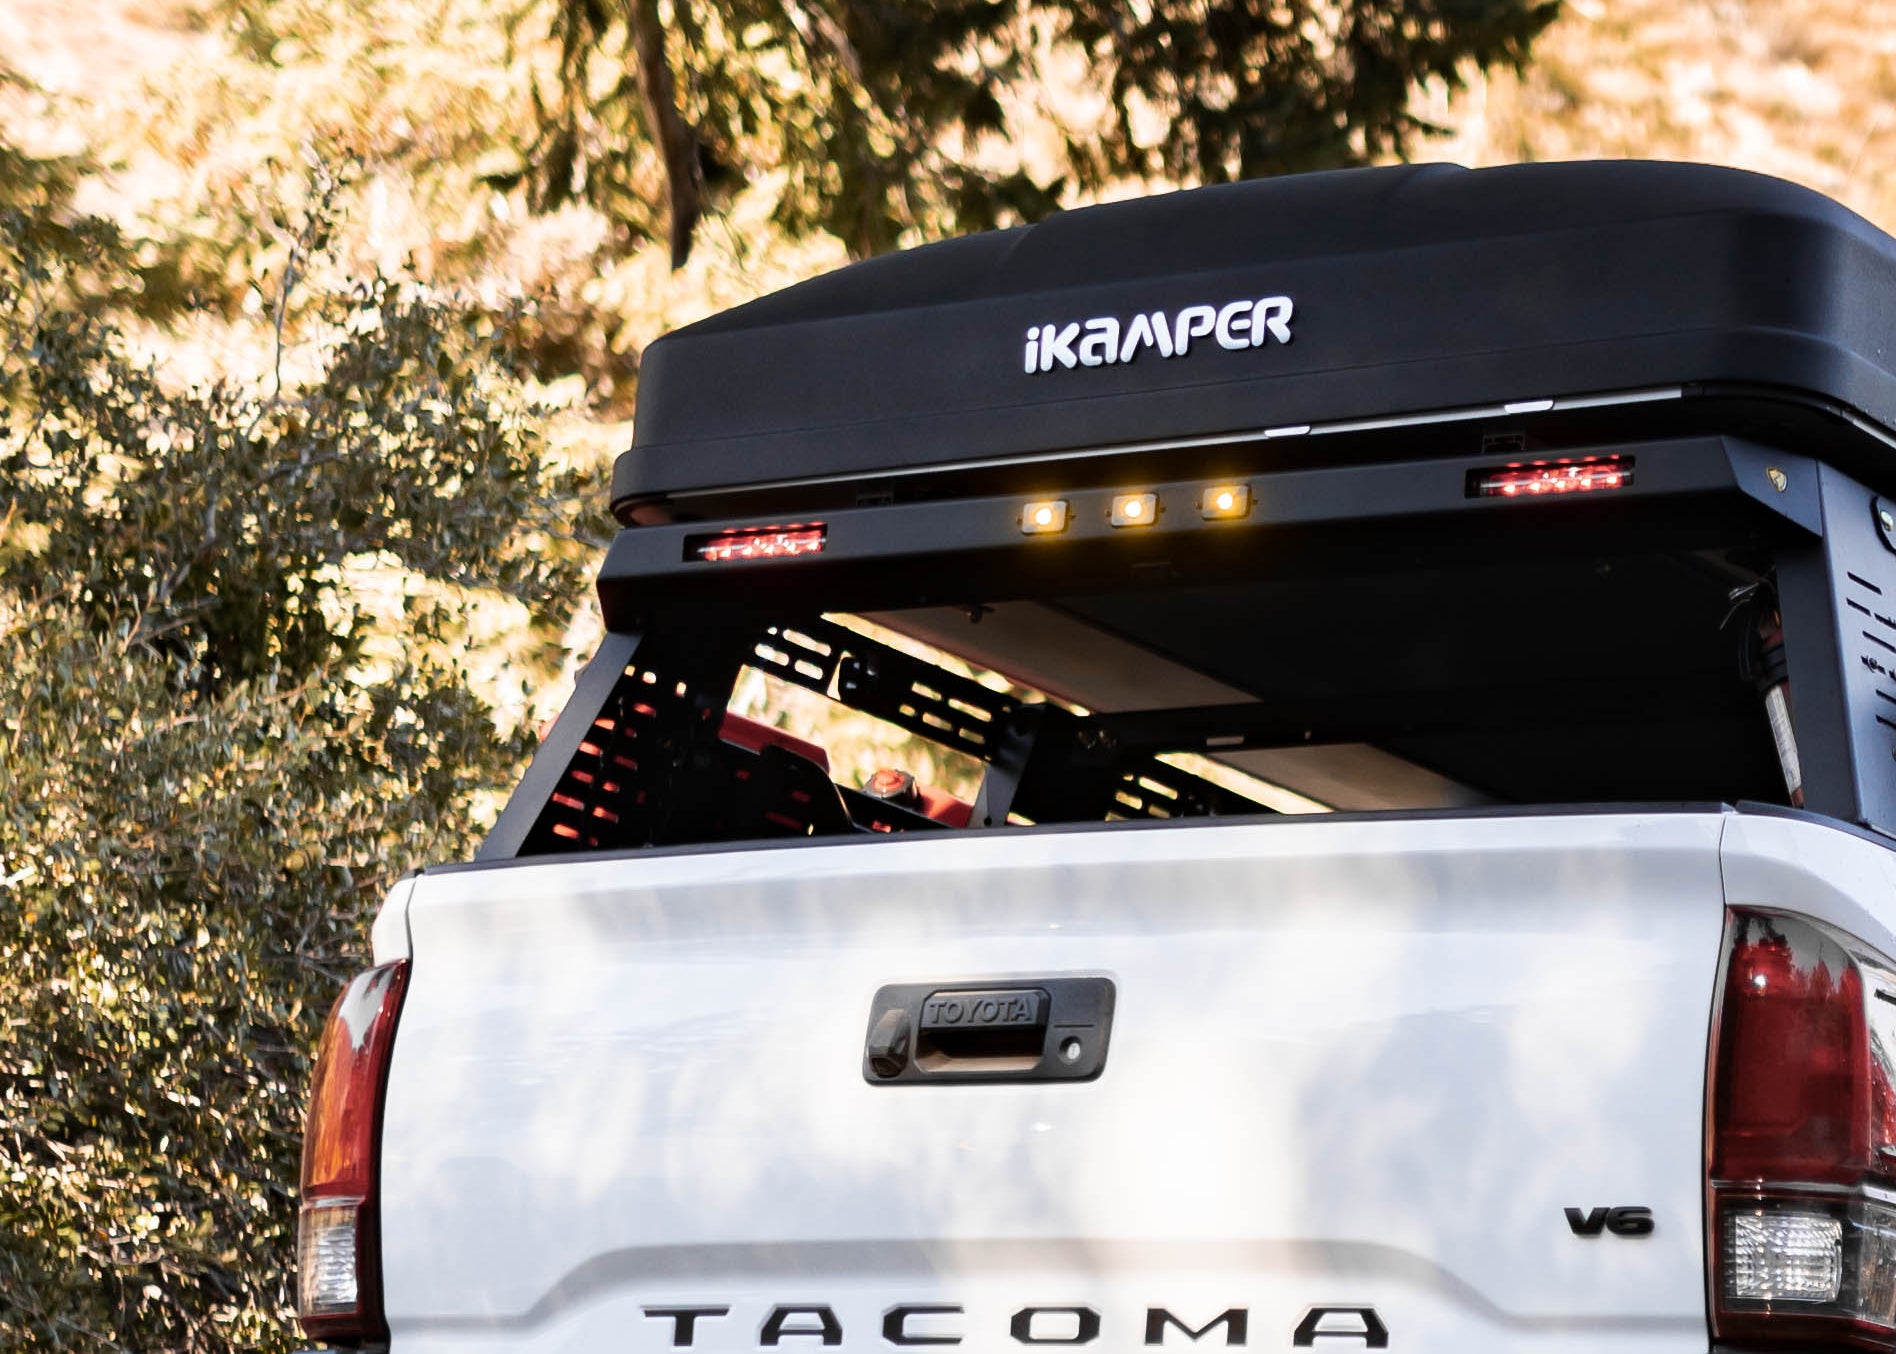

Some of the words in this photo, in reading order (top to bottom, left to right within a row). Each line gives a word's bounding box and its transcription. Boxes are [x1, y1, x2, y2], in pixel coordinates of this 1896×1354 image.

[930, 999, 1033, 1024] TOYOTA
[1563, 1206, 1655, 1239] V6
[640, 1305, 1390, 1348] TACOMA
